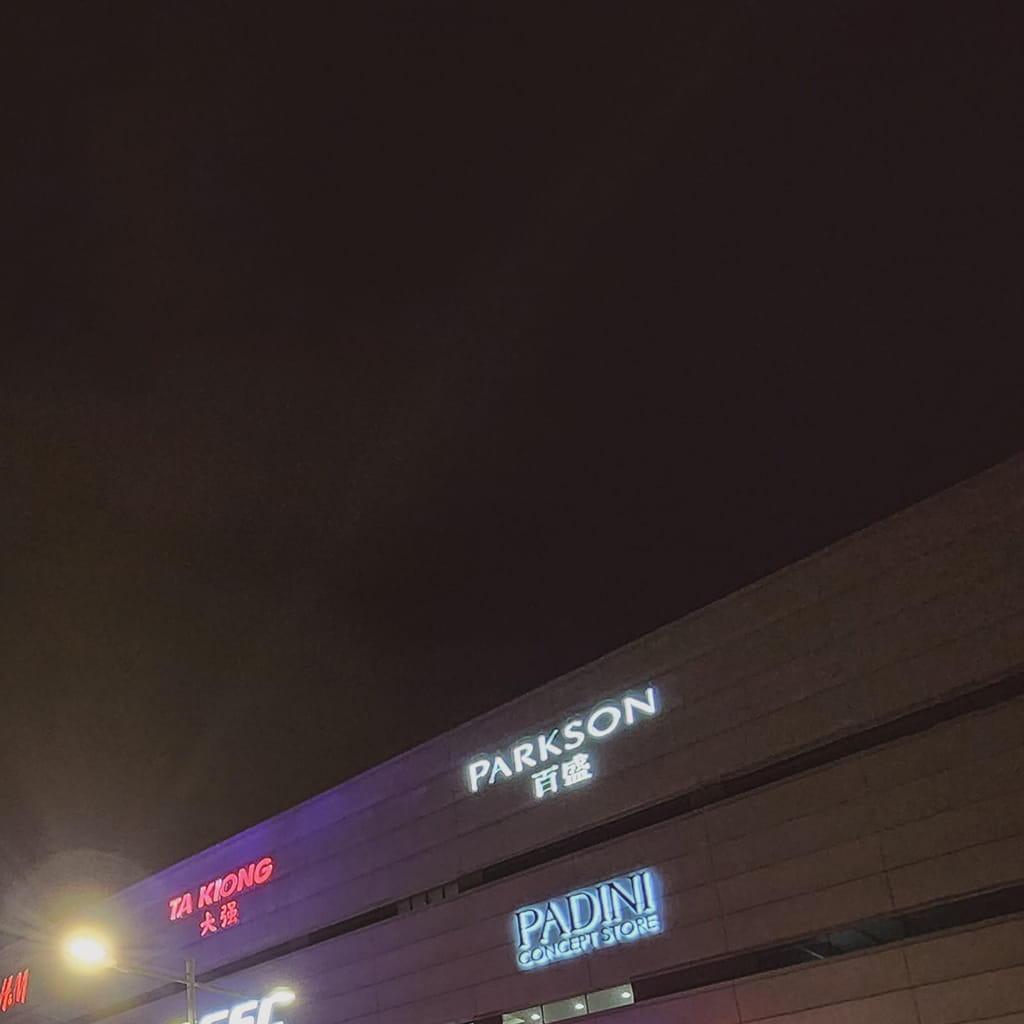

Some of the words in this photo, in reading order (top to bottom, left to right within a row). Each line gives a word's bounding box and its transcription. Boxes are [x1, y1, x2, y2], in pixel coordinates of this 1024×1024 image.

[468, 686, 657, 793] PARKSON
[531, 752, 593, 798] 百盛
[168, 892, 193, 921] TA
[197, 856, 274, 909] KIONG
[514, 871, 655, 948] PADINI
[199, 900, 240, 936] 大强
[517, 933, 598, 966] CONCEPT
[600, 914, 660, 943] STORE
